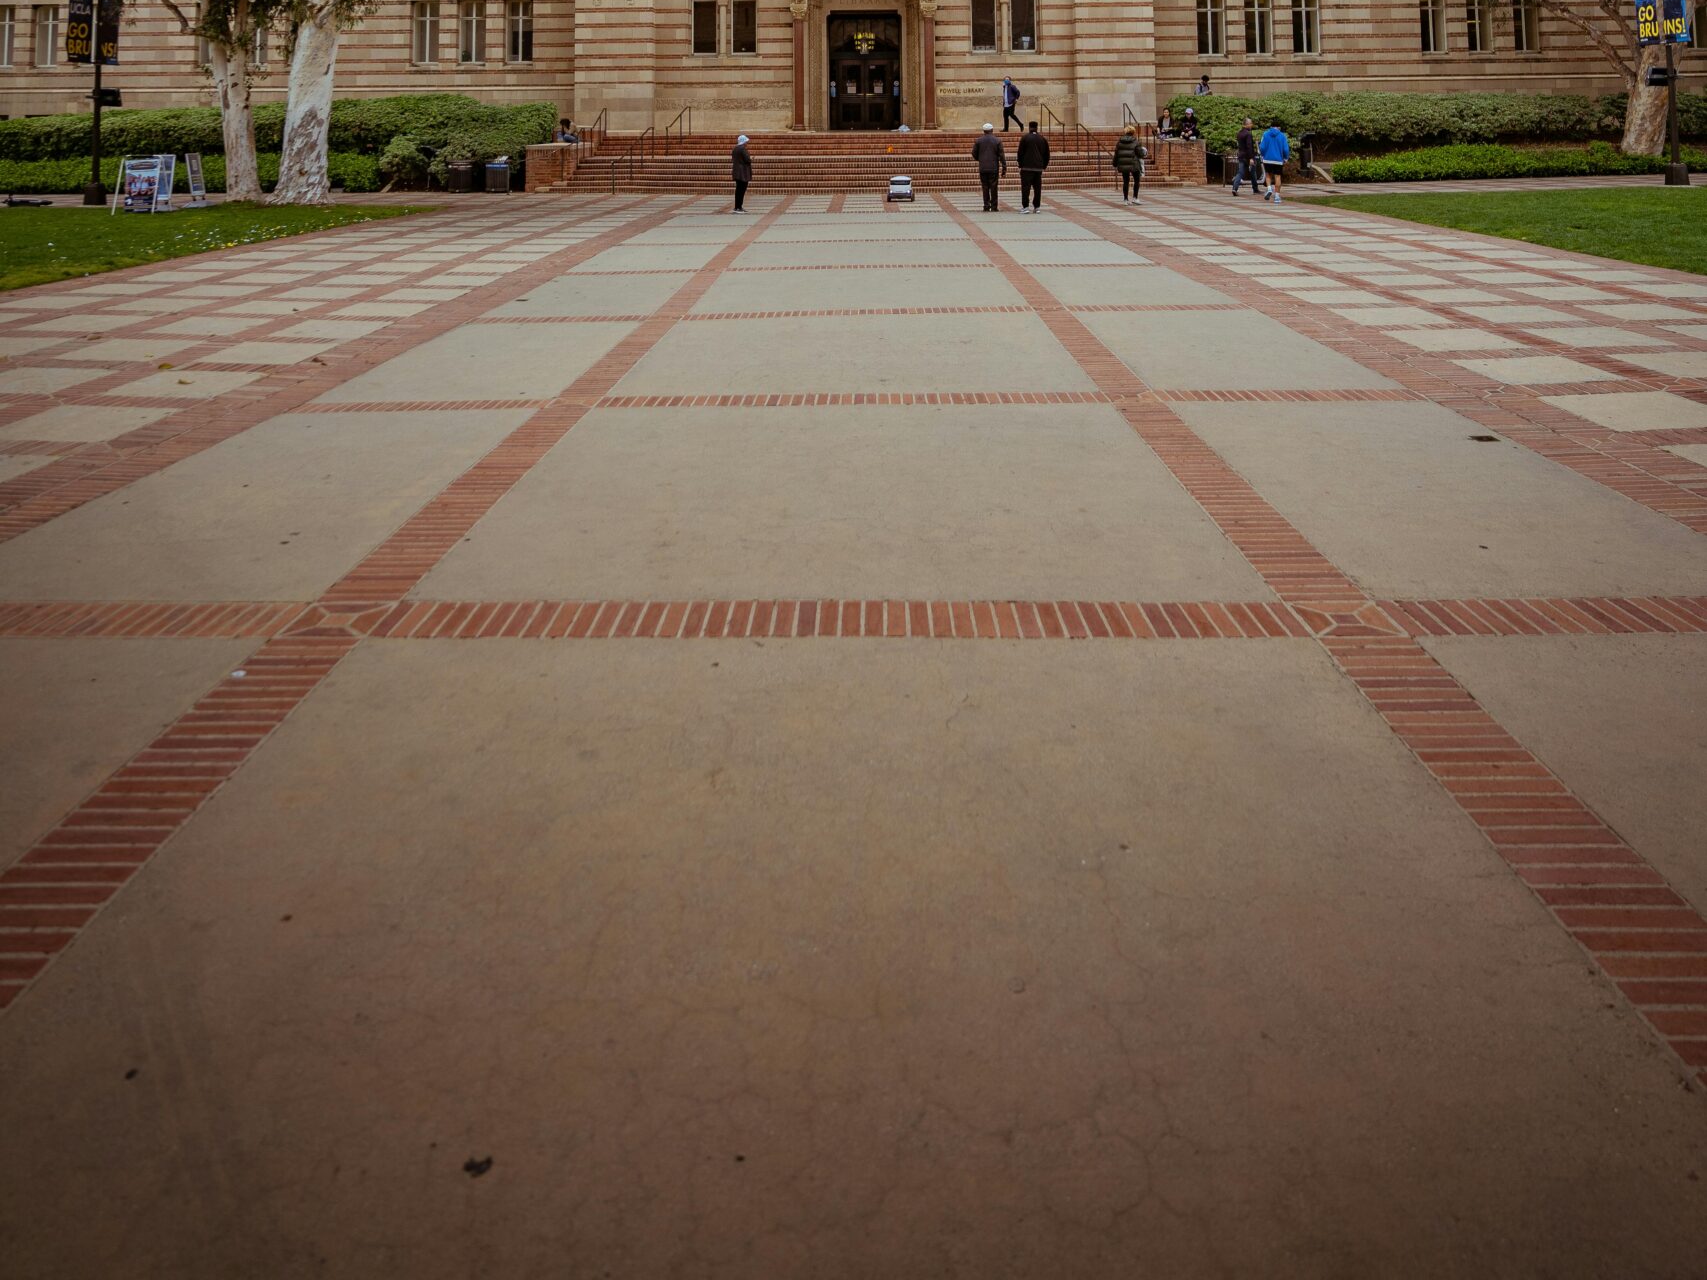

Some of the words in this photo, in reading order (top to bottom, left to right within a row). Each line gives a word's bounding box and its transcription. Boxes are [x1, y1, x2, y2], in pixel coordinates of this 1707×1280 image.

[70, 2, 91, 15] UCLA
[1638, 5, 1654, 21] GO
[69, 22, 88, 38] GO
[67, 39, 117, 58] BRUNS!
